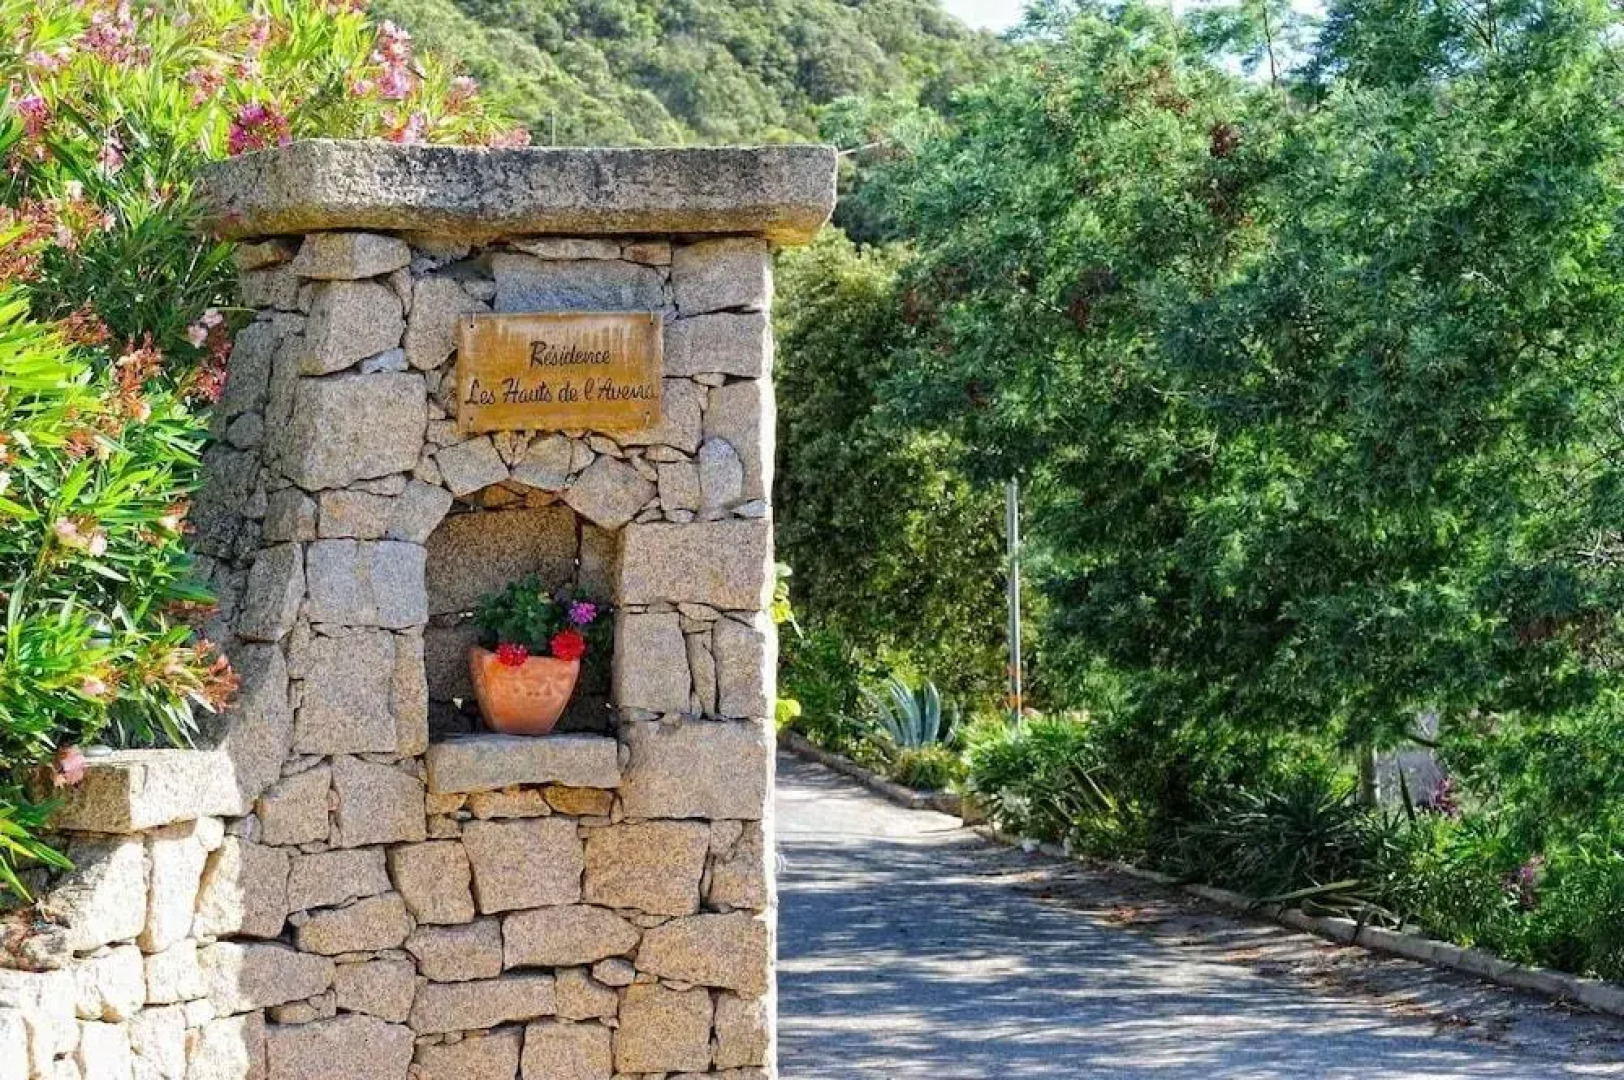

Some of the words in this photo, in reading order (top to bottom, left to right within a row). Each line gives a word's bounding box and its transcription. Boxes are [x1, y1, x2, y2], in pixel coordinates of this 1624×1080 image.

[530, 340, 610, 367] Résidence
[464, 378, 496, 405] Les
[502, 377, 553, 403] Hauts
[558, 380, 580, 403] de
